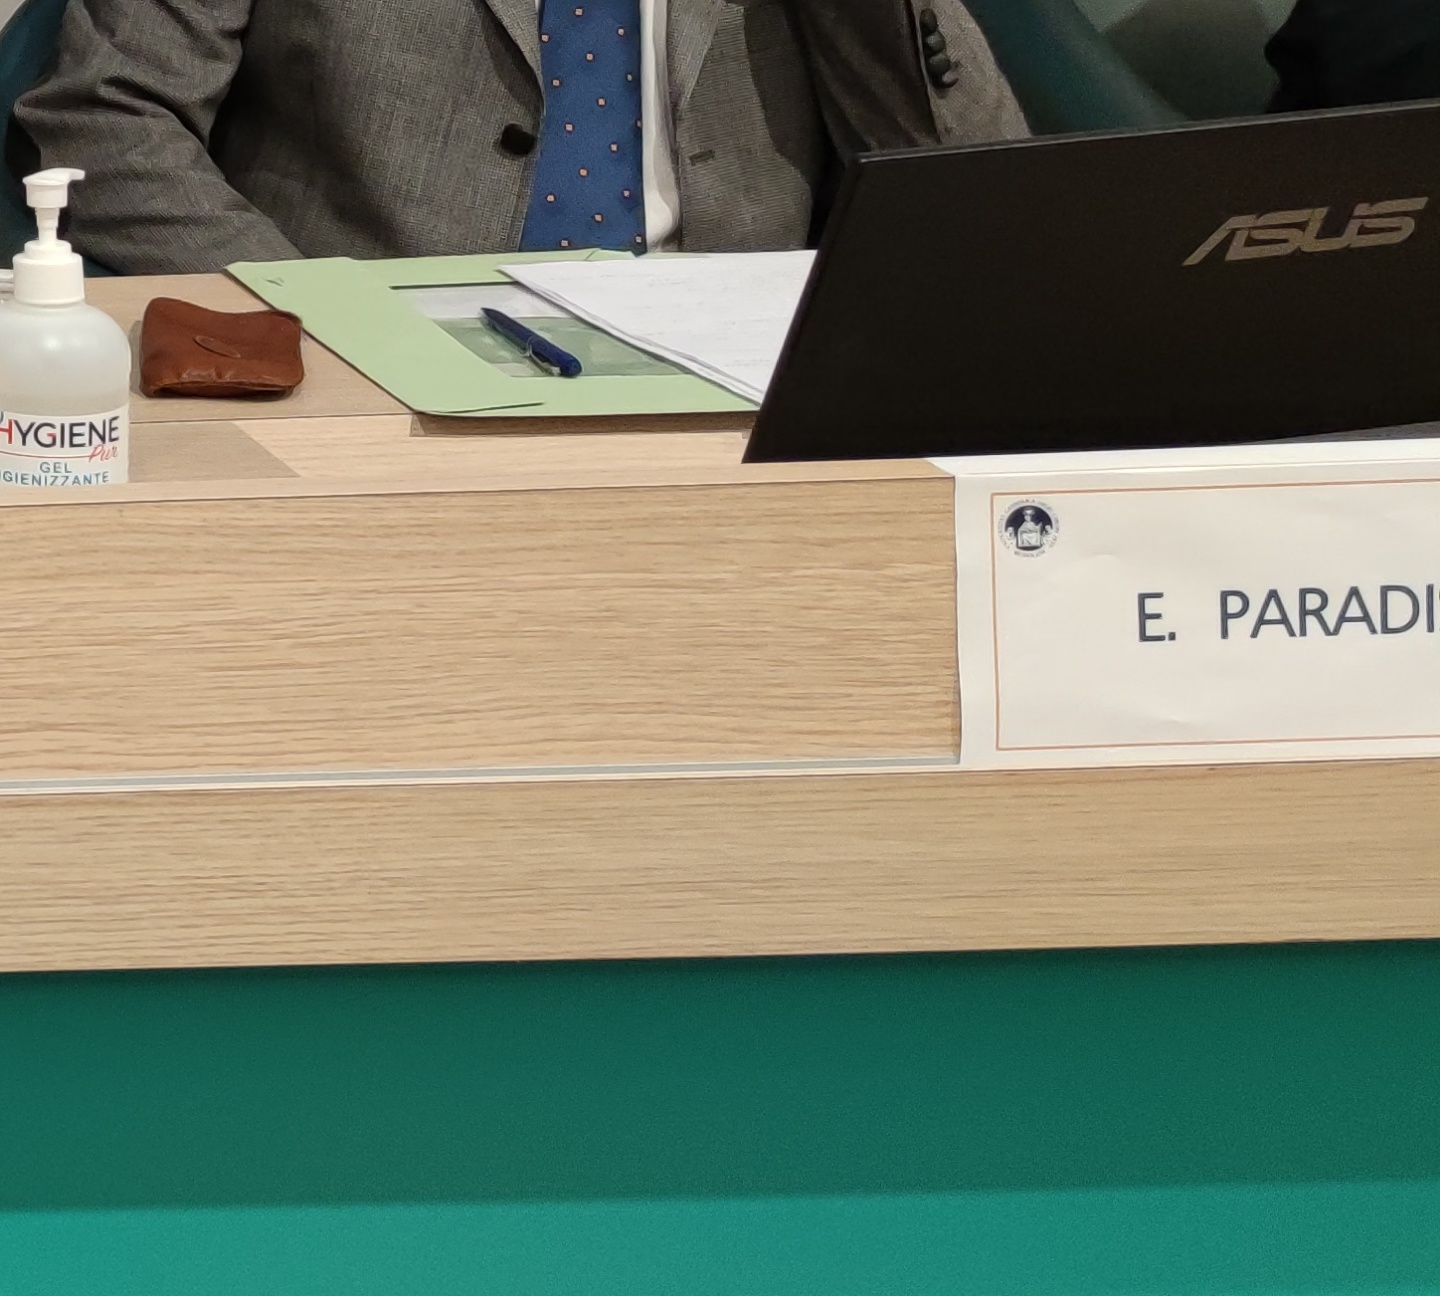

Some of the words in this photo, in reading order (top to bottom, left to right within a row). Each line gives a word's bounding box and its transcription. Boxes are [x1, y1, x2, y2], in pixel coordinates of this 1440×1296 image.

[1182, 197, 1429, 266] ASUS
[39, 461, 73, 474] GEL
[1138, 591, 1176, 642] E.
[1220, 583, 1440, 639] PARADI
